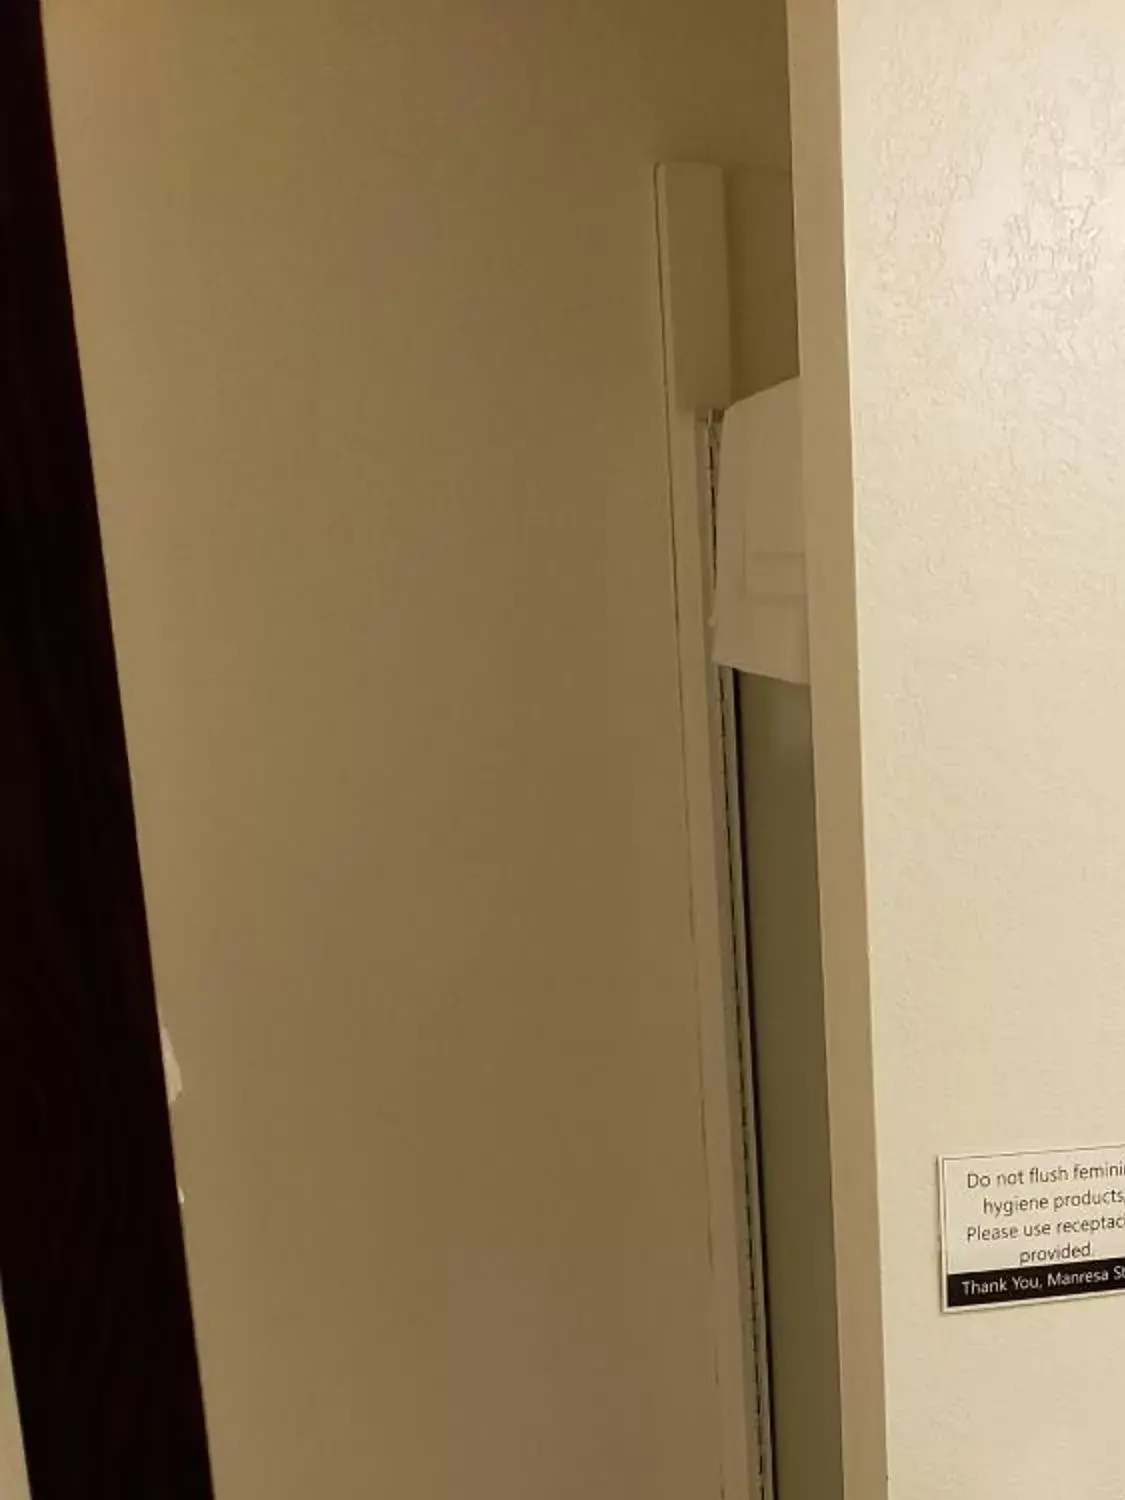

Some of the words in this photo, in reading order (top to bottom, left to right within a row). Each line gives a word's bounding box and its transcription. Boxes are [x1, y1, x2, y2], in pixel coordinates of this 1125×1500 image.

[967, 1172, 991, 1189] Do
[996, 1170, 1025, 1187] not
[1029, 1166, 1069, 1184] flush
[983, 1196, 1050, 1217] hygiene
[966, 1226, 1019, 1242] Please
[1023, 1222, 1051, 1238] use
[961, 1277, 1009, 1297] Thank
[1047, 1270, 1110, 1288] Manresa
